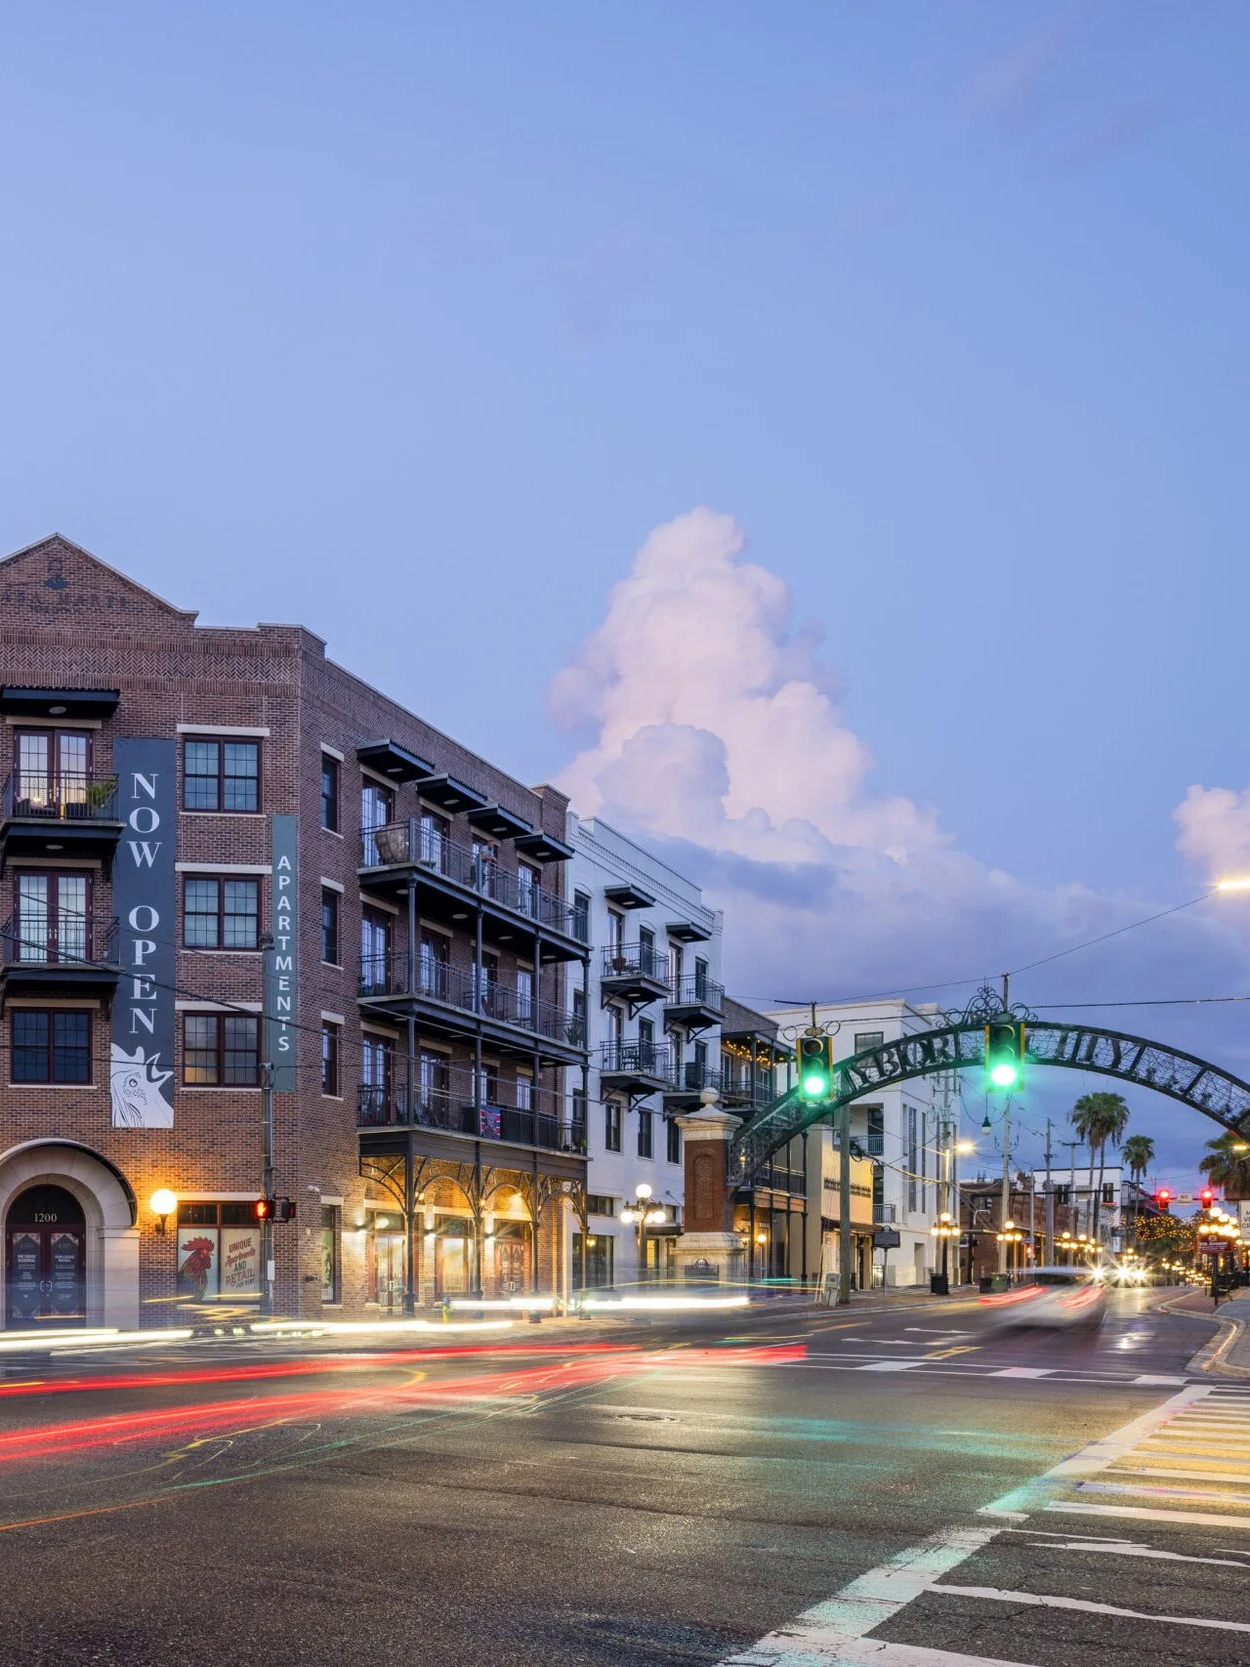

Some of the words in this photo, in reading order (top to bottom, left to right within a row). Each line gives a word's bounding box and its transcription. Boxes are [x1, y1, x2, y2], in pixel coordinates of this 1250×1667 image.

[126, 773, 163, 869] NOW
[128, 905, 160, 1034] OPEN
[275, 855, 293, 1052] APARTMENTS
[852, 1036, 954, 1087] YBOR
[34, 1213, 57, 1223] 1200
[228, 1237, 252, 1253] UNIQUE
[225, 1268, 255, 1287] RETAIL
[234, 1260, 247, 1272] AND
